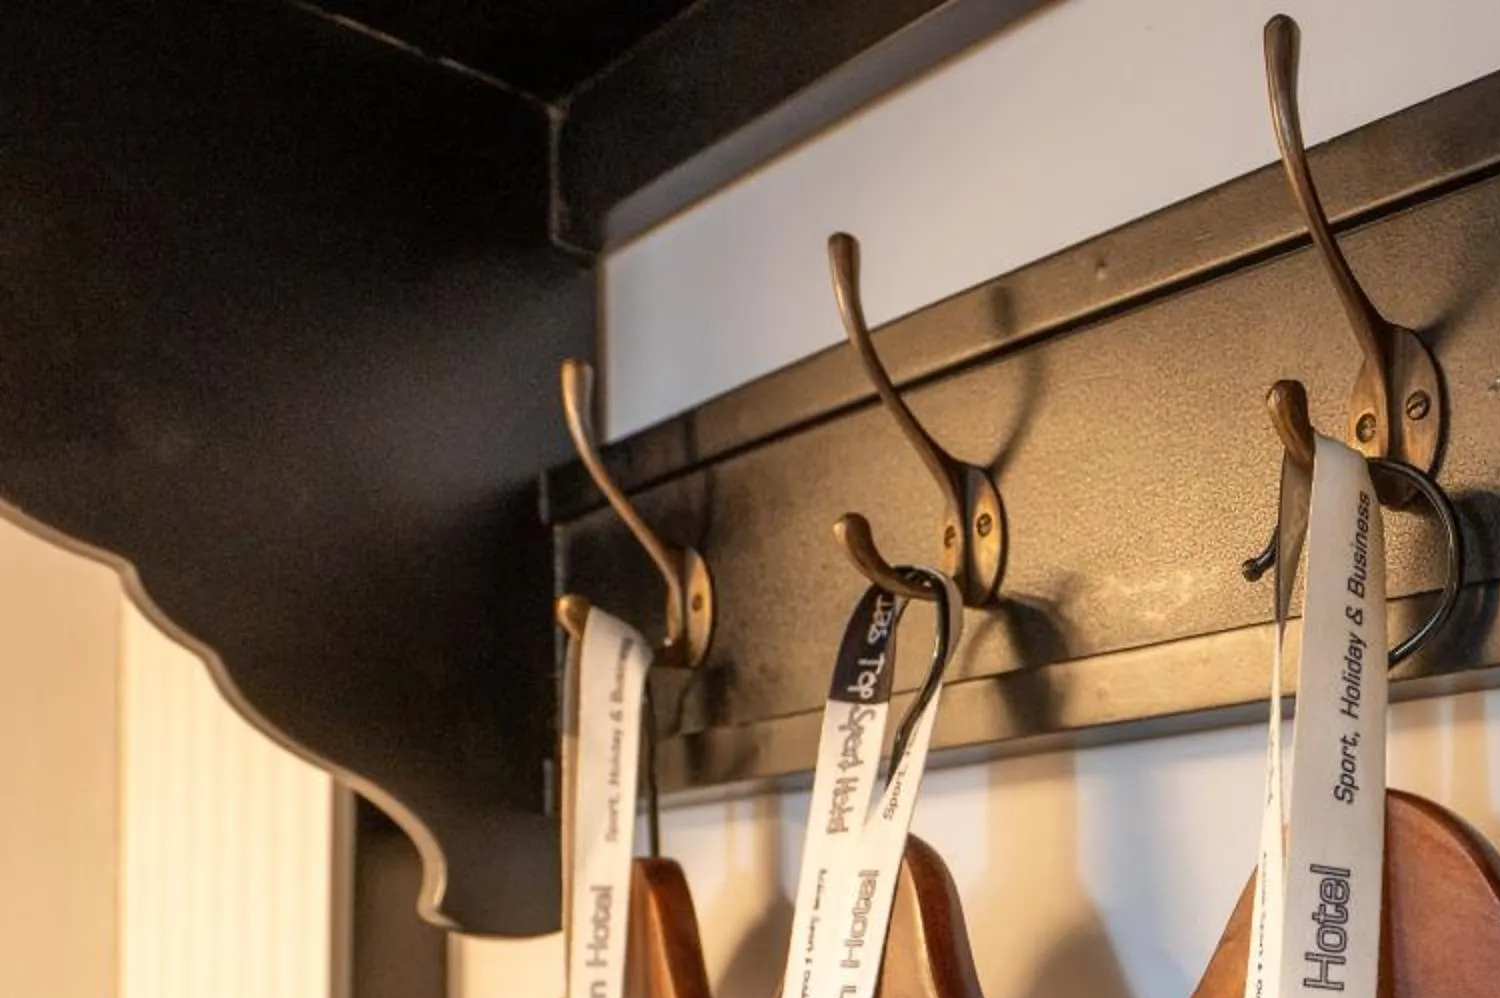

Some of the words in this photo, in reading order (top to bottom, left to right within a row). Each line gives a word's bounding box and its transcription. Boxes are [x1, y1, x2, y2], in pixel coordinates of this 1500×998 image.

[1347, 494, 1371, 599] Business
[1345, 606, 1364, 628] &
[848, 652, 886, 701] Top
[1340, 631, 1368, 719] Holiday
[838, 703, 877, 773] Sport
[1333, 732, 1361, 804] Sport,
[586, 885, 614, 968] Hotel
[840, 869, 880, 970] Hotel
[1303, 864, 1352, 992] Hotel
